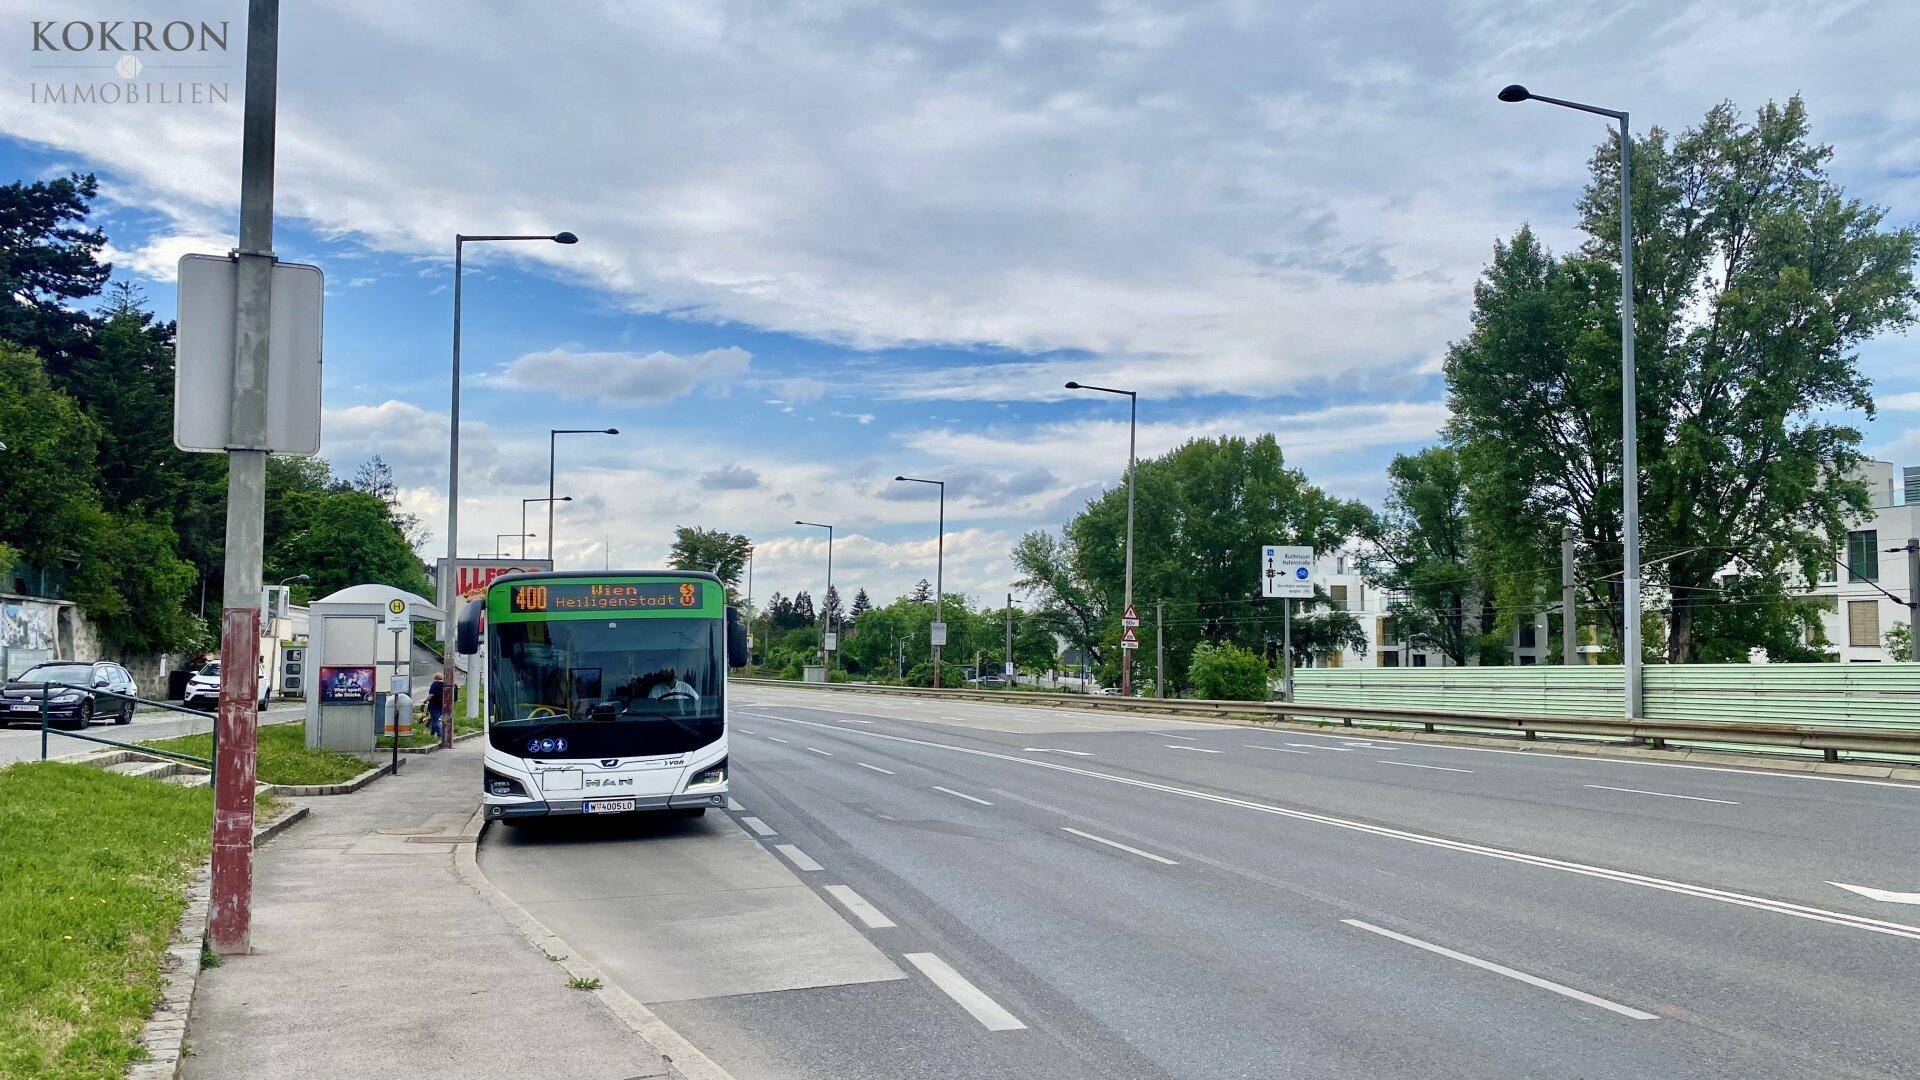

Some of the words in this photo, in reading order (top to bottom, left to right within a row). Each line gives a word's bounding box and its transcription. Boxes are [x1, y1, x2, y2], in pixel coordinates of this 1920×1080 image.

[591, 584, 638, 596] Wien
[516, 585, 547, 610] 400
[556, 594, 675, 608] Heiligenstadt
[585, 778, 634, 788] MAN
